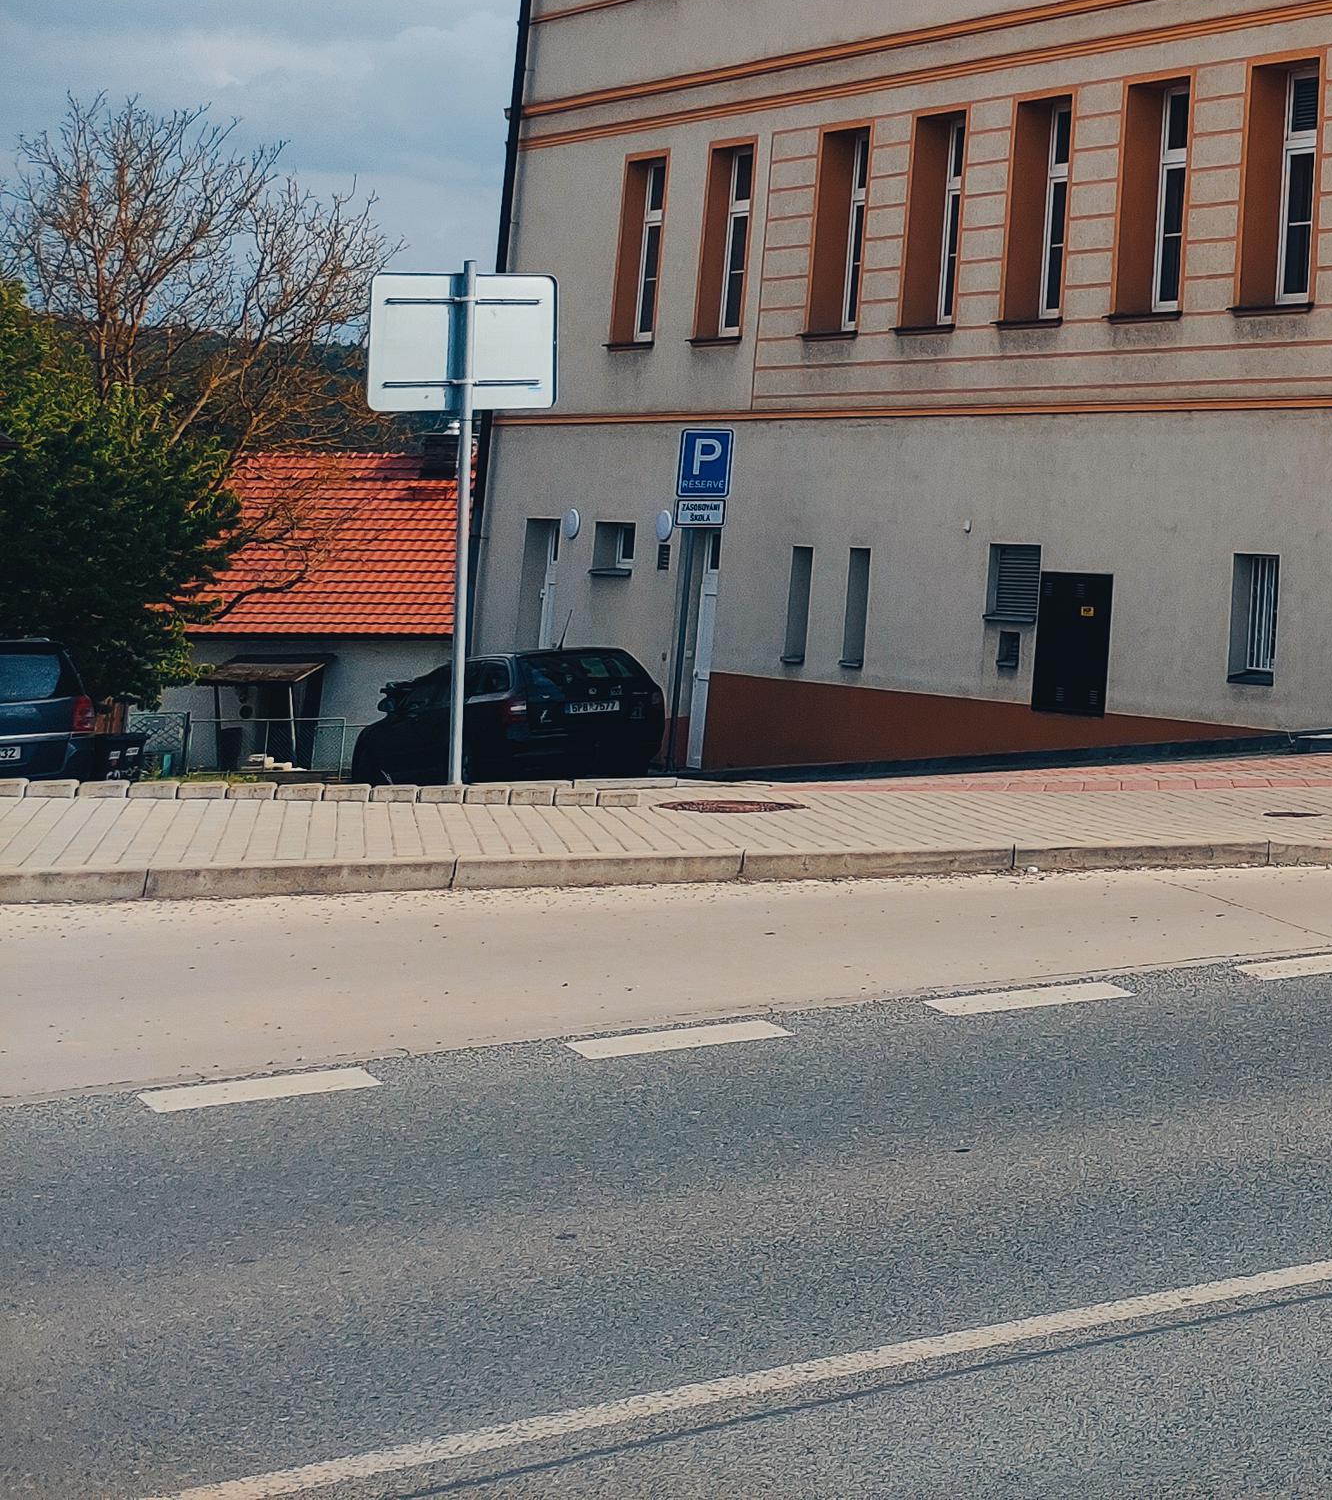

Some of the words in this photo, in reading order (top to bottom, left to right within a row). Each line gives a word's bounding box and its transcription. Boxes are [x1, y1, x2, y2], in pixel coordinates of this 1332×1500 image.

[692, 438, 723, 475] P
[689, 512, 711, 522] ŠKOLA
[0, 747, 17, 759] 32
